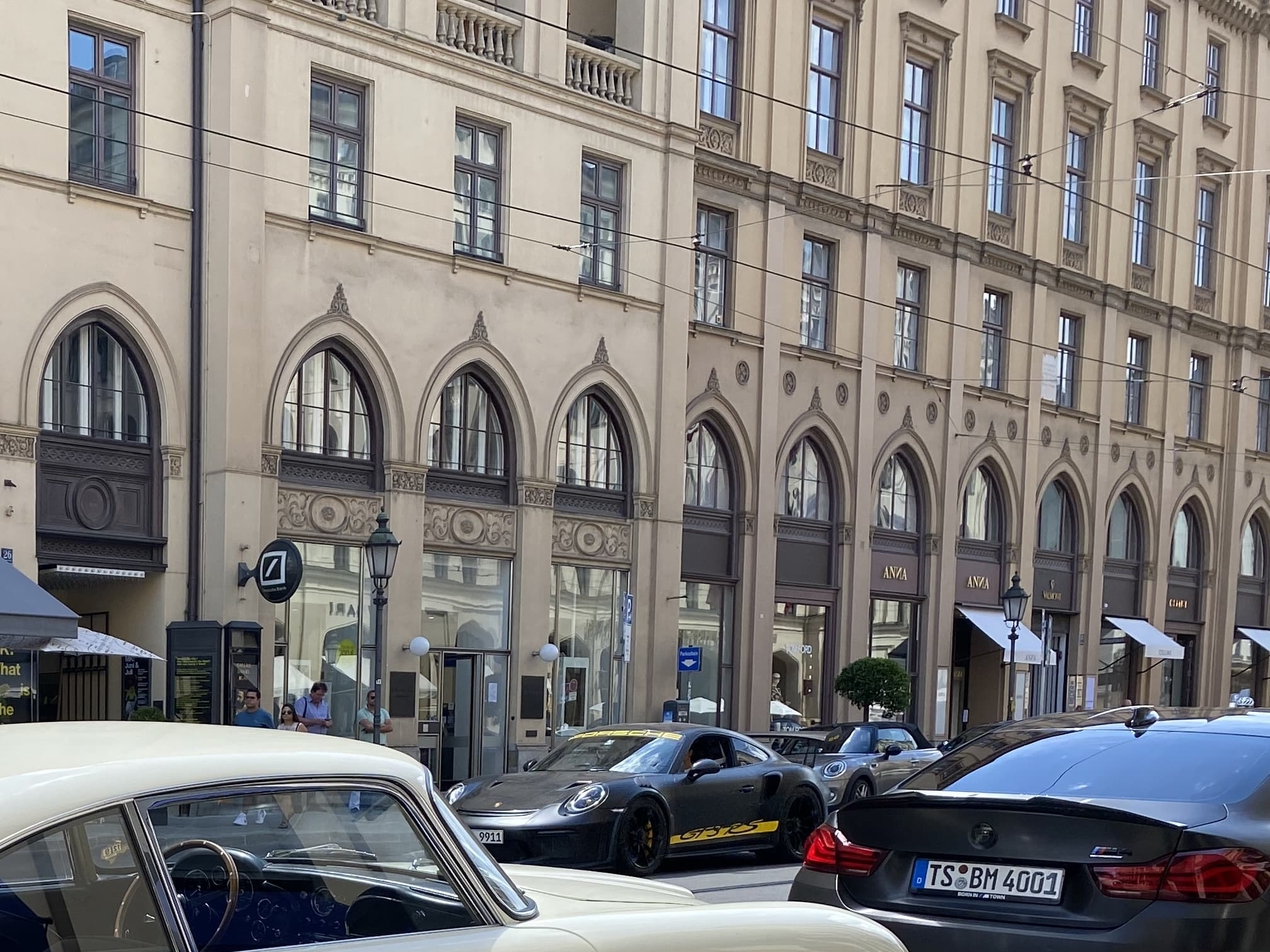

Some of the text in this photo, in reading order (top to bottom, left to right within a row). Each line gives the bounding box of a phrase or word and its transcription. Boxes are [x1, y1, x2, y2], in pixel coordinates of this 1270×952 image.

[2, 550, 12, 559] 26
[20, 682, 31, 697] is
[479, 831, 502, 843] 9911
[930, 864, 1058, 896] TS BM 4001
